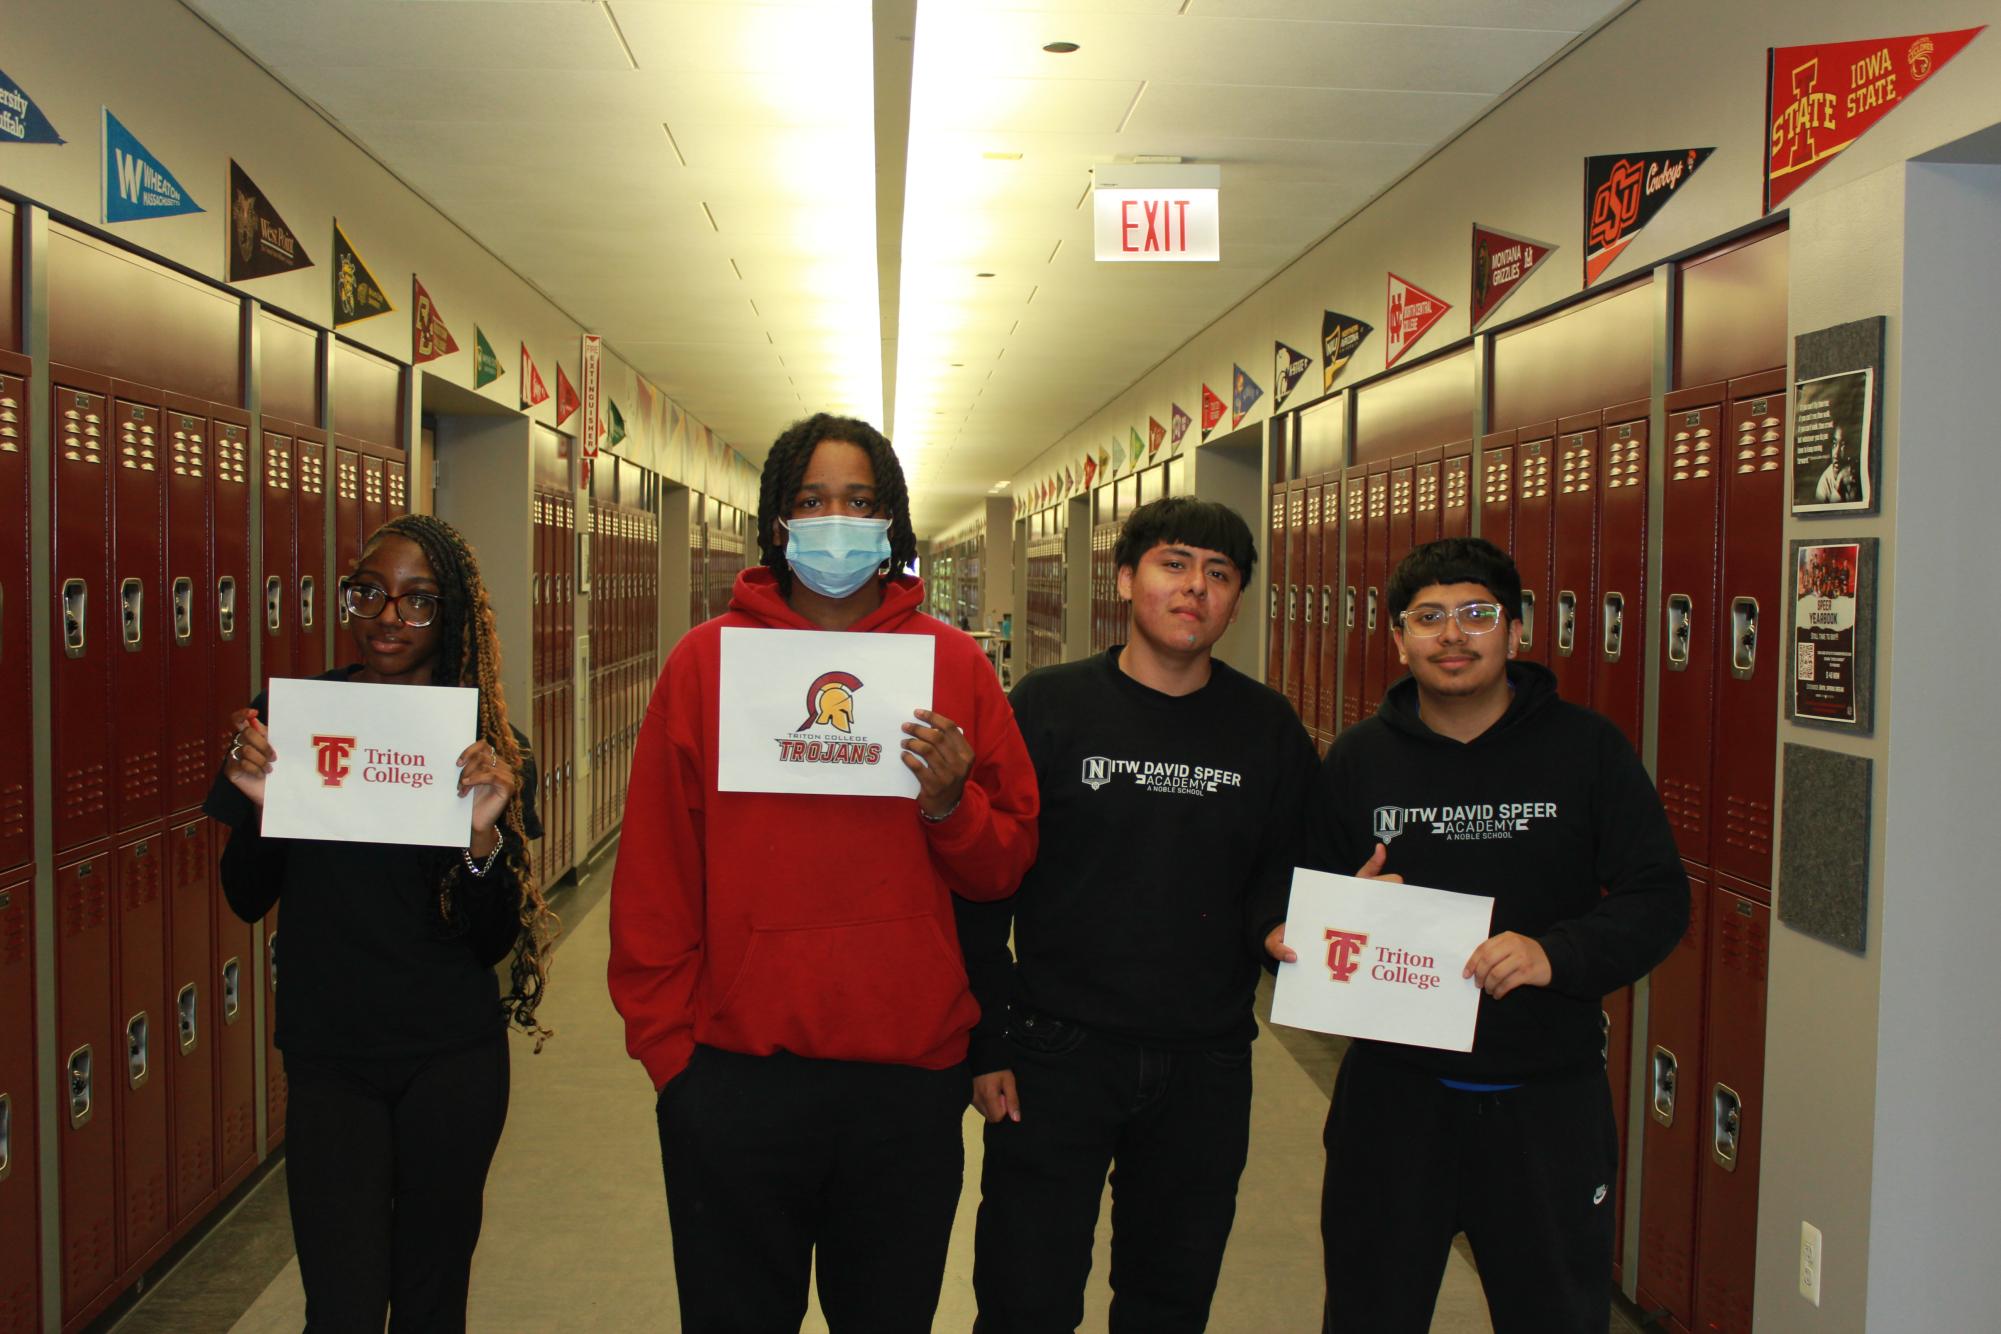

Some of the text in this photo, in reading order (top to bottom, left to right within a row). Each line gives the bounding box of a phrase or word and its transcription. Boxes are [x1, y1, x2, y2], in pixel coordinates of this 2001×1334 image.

[1850, 48, 1892, 89] IOWA
[1847, 74, 1896, 118] STATE
[1772, 92, 1836, 157] STATE
[115, 147, 144, 204] W
[143, 161, 181, 201] WHEATON
[1645, 160, 1683, 196] Cowboys
[1121, 200, 1190, 252] EXIT
[1492, 245, 1521, 269] MONTANA
[1493, 263, 1520, 285] GRIZZLIES
[587, 355, 595, 447] EXTINGUISHER
[1817, 600, 1832, 611] SPEER
[1809, 613, 1838, 624] YEARBOOK
[788, 732, 822, 740] TRITON
[364, 748, 426, 767] Triton
[774, 739, 883, 766] TROJANS
[363, 766, 434, 789] College
[1088, 759, 1105, 779] N
[1111, 760, 1242, 788] ITW DAVID SPEER
[1146, 775, 1208, 790] ACADEMY
[1153, 786, 1176, 794] NOBLE
[1177, 787, 1204, 797] SCHOOL
[1379, 809, 1397, 831] N
[1404, 803, 1558, 823] ITW DAVID SPEER
[1445, 819, 1516, 834] ACADEMY
[1446, 830, 1513, 841] A NOBLE SCHOOL
[1375, 946, 1434, 969] Triton
[1371, 964, 1441, 990] College
